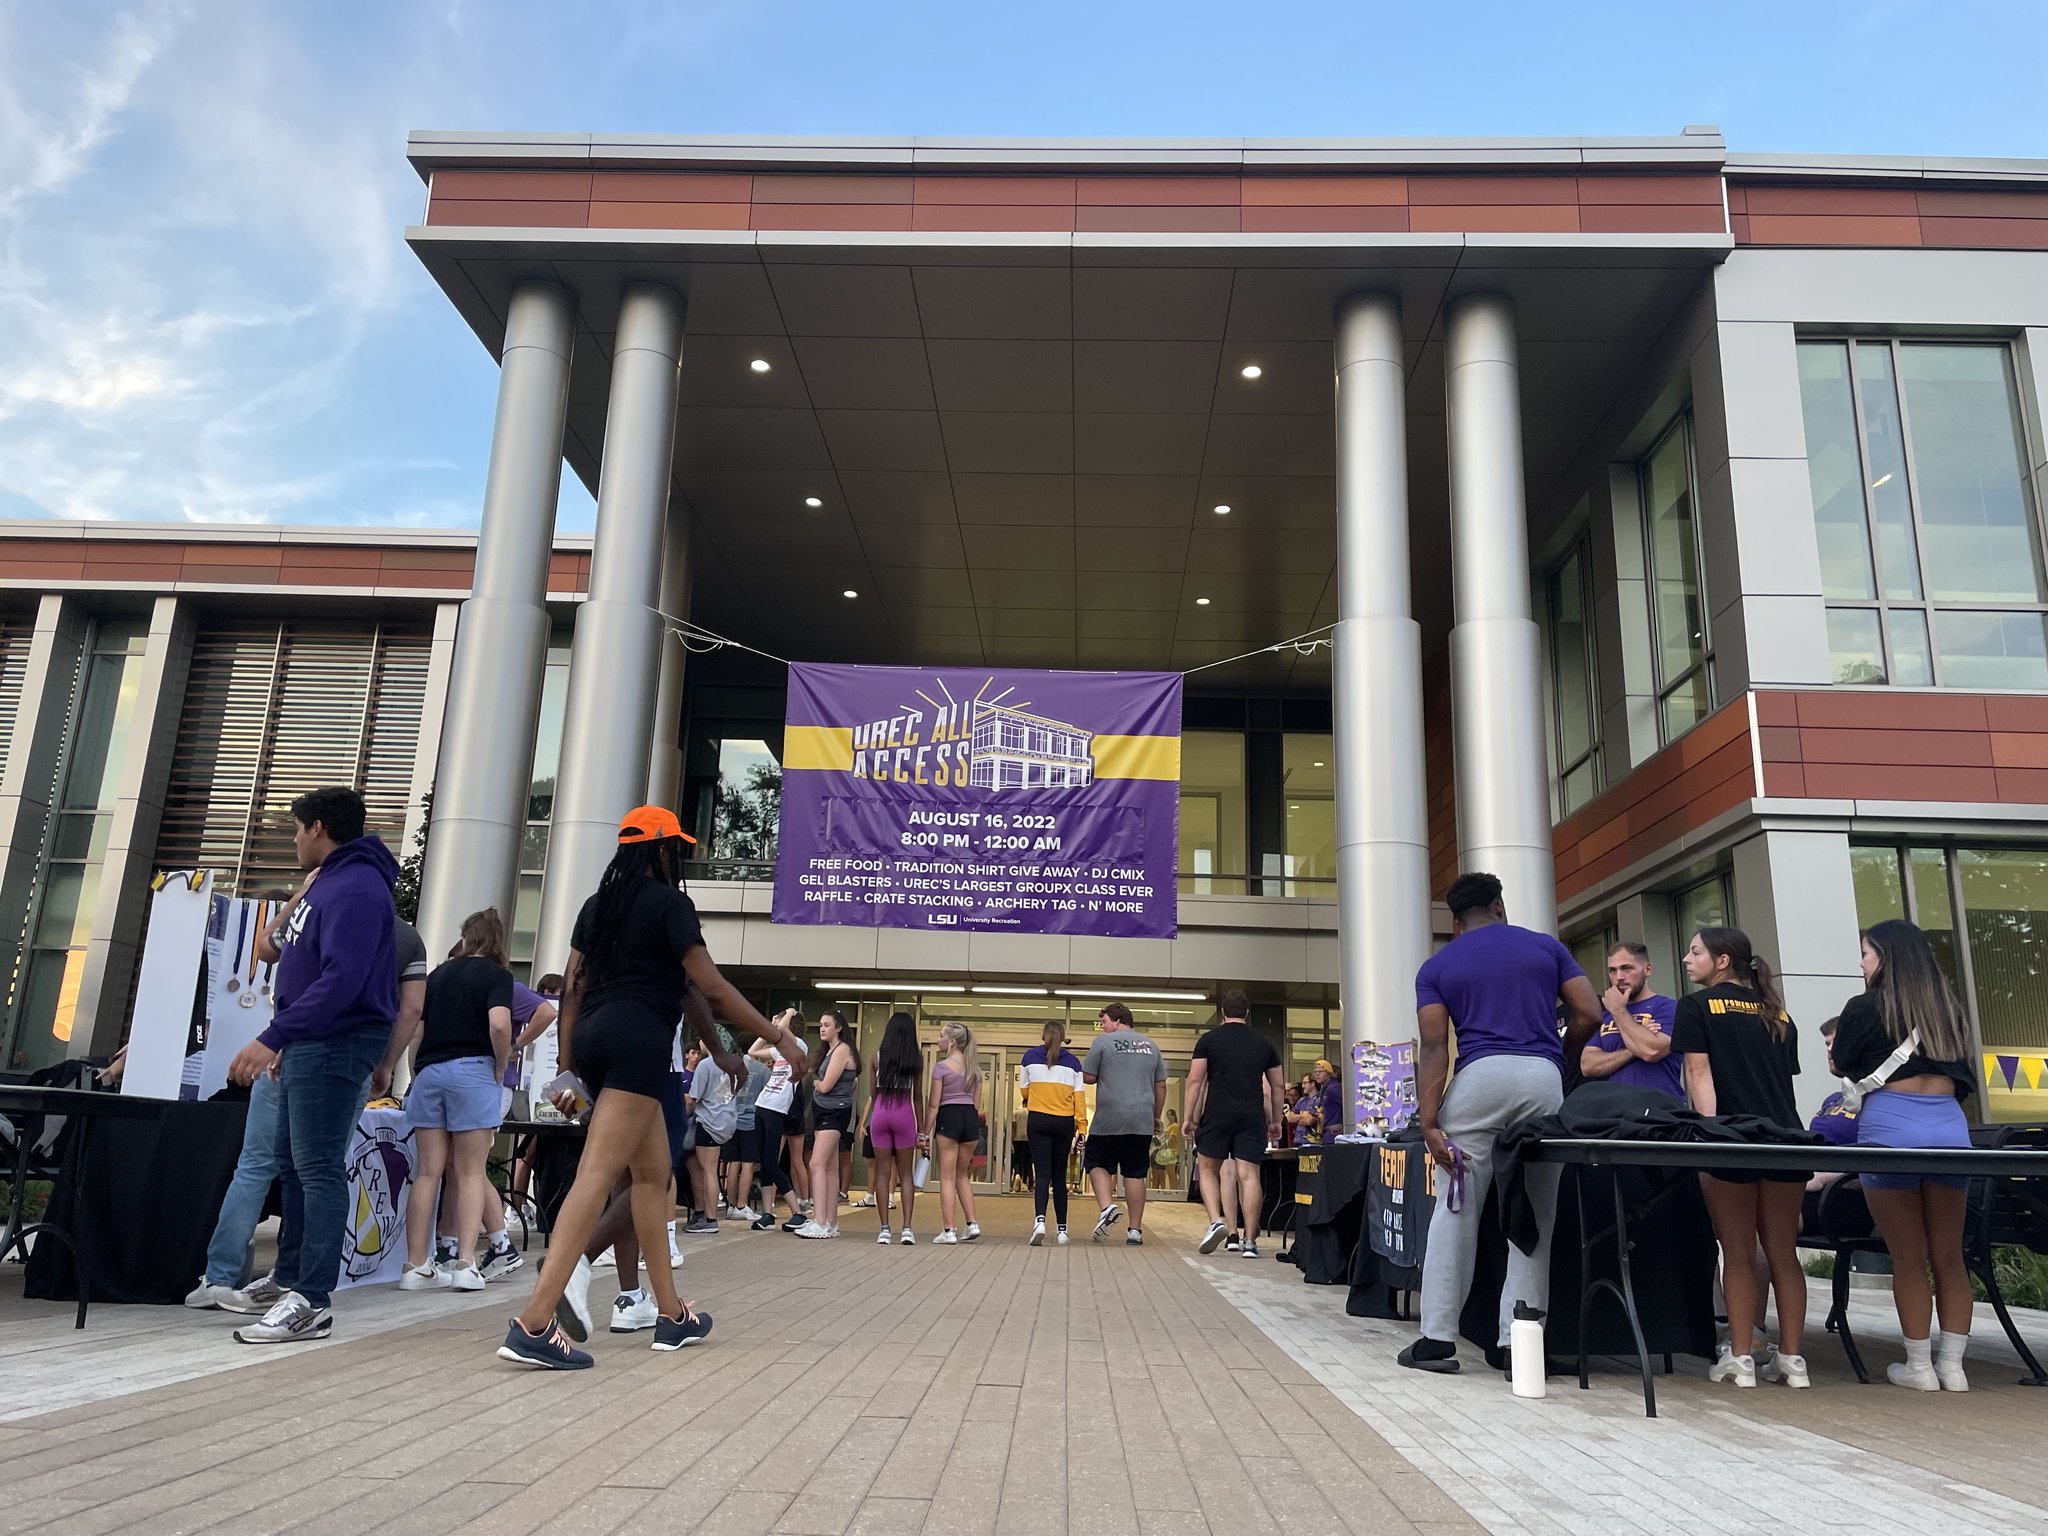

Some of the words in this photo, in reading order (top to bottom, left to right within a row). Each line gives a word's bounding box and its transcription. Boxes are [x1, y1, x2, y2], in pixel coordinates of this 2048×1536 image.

[854, 712, 923, 749] UREC
[930, 701, 972, 743] ALL
[853, 741, 969, 787] ACCESS
[909, 811, 980, 827] AUGUST
[984, 814, 1008, 829] 16,
[1012, 815, 1056, 829] 2022
[901, 832, 938, 845] 8:00
[943, 834, 969, 847] PM
[984, 835, 1029, 849] 12:00
[1033, 837, 1061, 850] AM
[809, 858, 841, 870] FREE
[844, 860, 882, 871] FOOD
[894, 862, 964, 875] TRADITION
[967, 864, 1006, 876] SHIRT
[1009, 866, 1040, 877] GIVE
[1042, 867, 1080, 878] AWAY
[1092, 868, 1107, 879] DJ
[1111, 869, 1145, 880] CMIX
[799, 874, 824, 886] GEL
[827, 875, 892, 888] BLASTERS
[903, 878, 950, 890] UREC'S
[953, 879, 1012, 892] LARGEST
[1015, 882, 1072, 894] GROUPX
[1075, 883, 1116, 896] CLASS
[1119, 886, 1153, 897] EVER
[804, 891, 852, 902] RAFFLE
[864, 892, 905, 905] CRATE
[908, 894, 973, 907] STACKING
[985, 897, 1048, 910] ARCHERY
[1051, 899, 1077, 910] TAG
[1088, 900, 1102, 911] N'
[1105, 901, 1143, 913] MORE
[928, 914, 957, 925] LSU
[963, 917, 990, 925] University
[991, 917, 1021, 925] Recreation
[1380, 1147, 1407, 1190] TEAM
